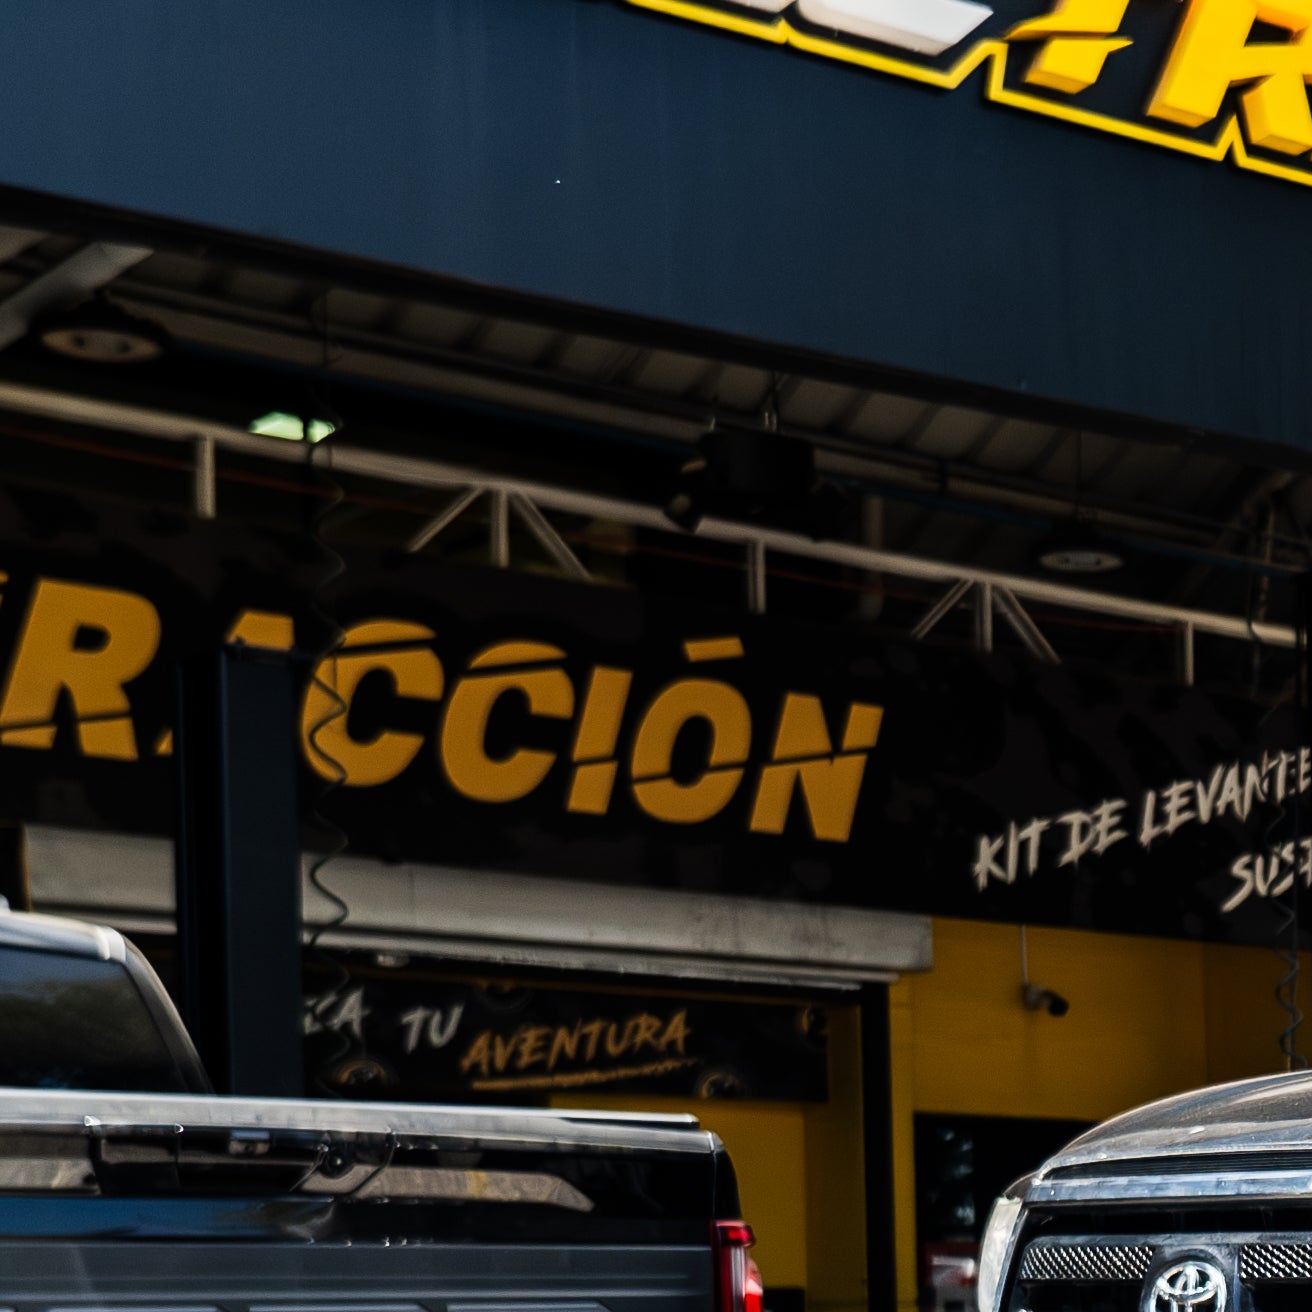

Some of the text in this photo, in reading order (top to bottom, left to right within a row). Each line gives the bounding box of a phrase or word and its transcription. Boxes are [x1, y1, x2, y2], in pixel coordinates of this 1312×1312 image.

[972, 819, 1050, 893] KIT
[1055, 798, 1130, 868] DE
[401, 1001, 467, 1054] TU
[460, 1010, 690, 1076] AVENTURA
